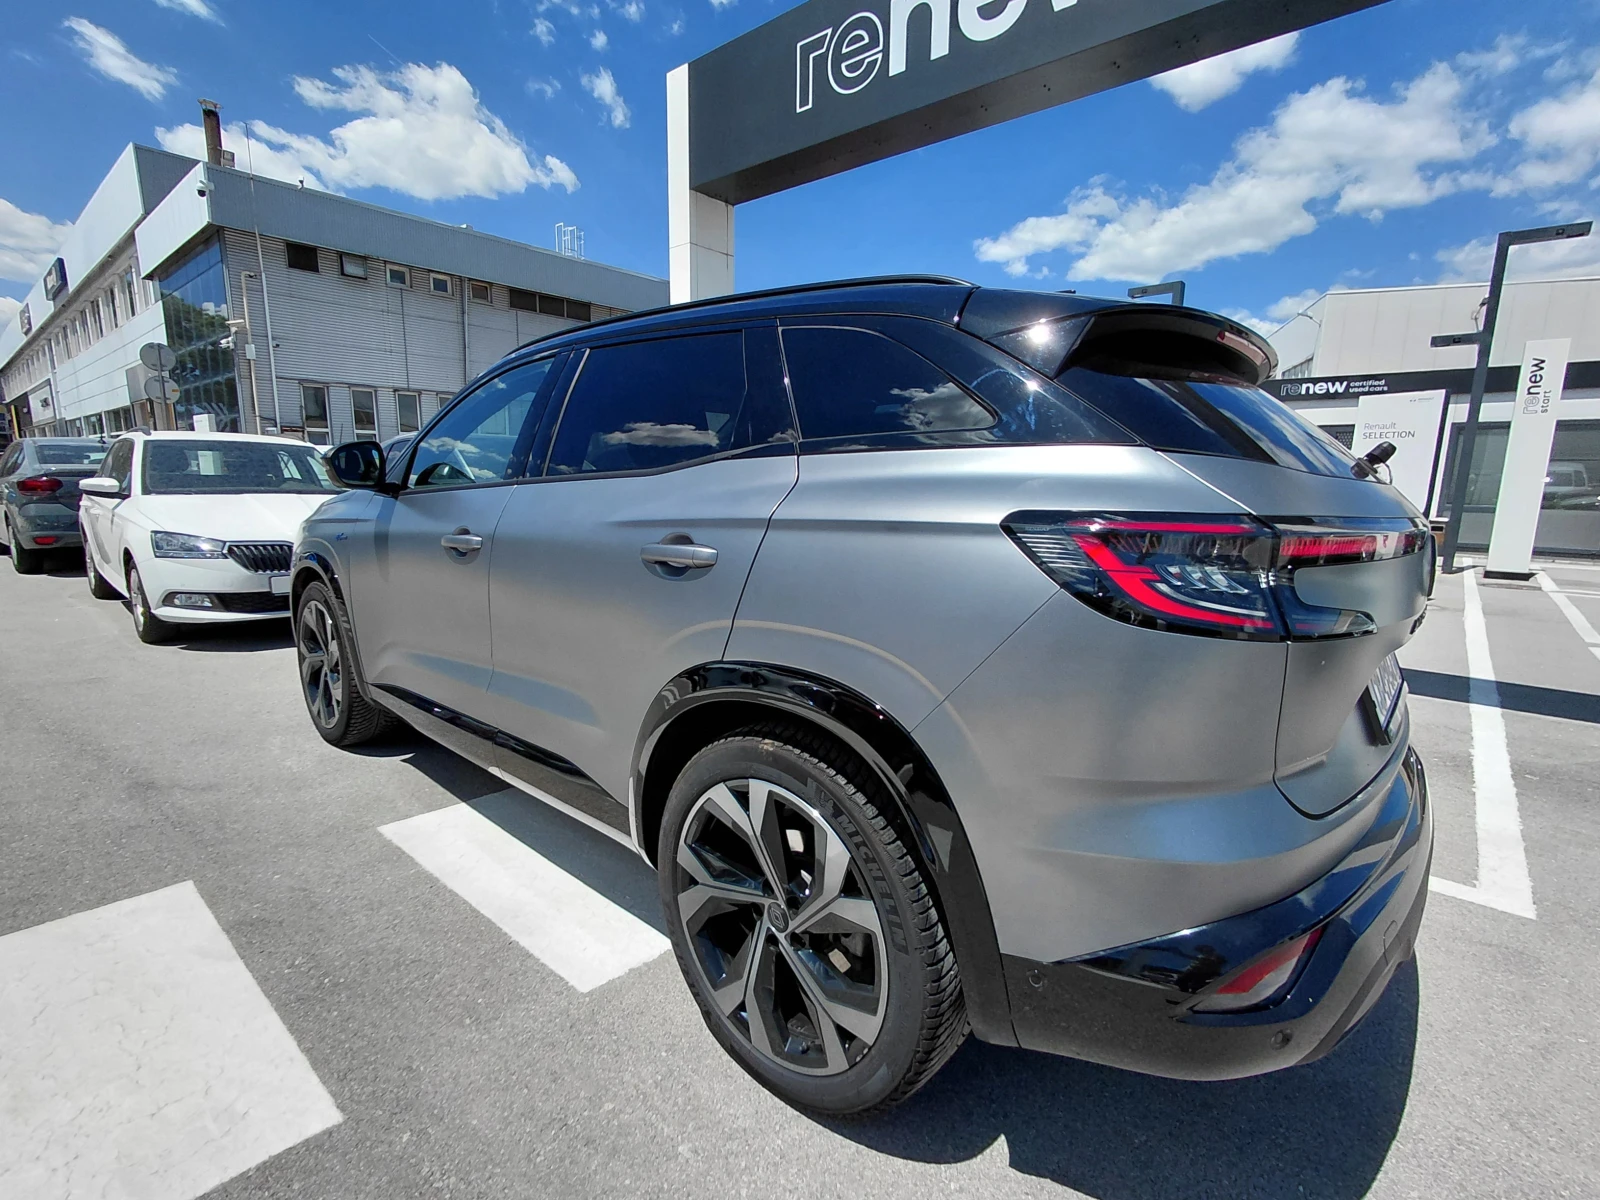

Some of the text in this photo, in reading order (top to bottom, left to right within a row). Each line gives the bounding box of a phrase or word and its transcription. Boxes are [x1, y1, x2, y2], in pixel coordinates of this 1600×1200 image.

[1280, 380, 1348, 396] renew
[1349, 379, 1385, 387] certified
[1522, 357, 1546, 415] renew
[1540, 389, 1552, 414] start
[1363, 421, 1397, 431] Renault
[1362, 430, 1416, 440] SELECTION
[836, 813, 909, 957] MICHELIN
